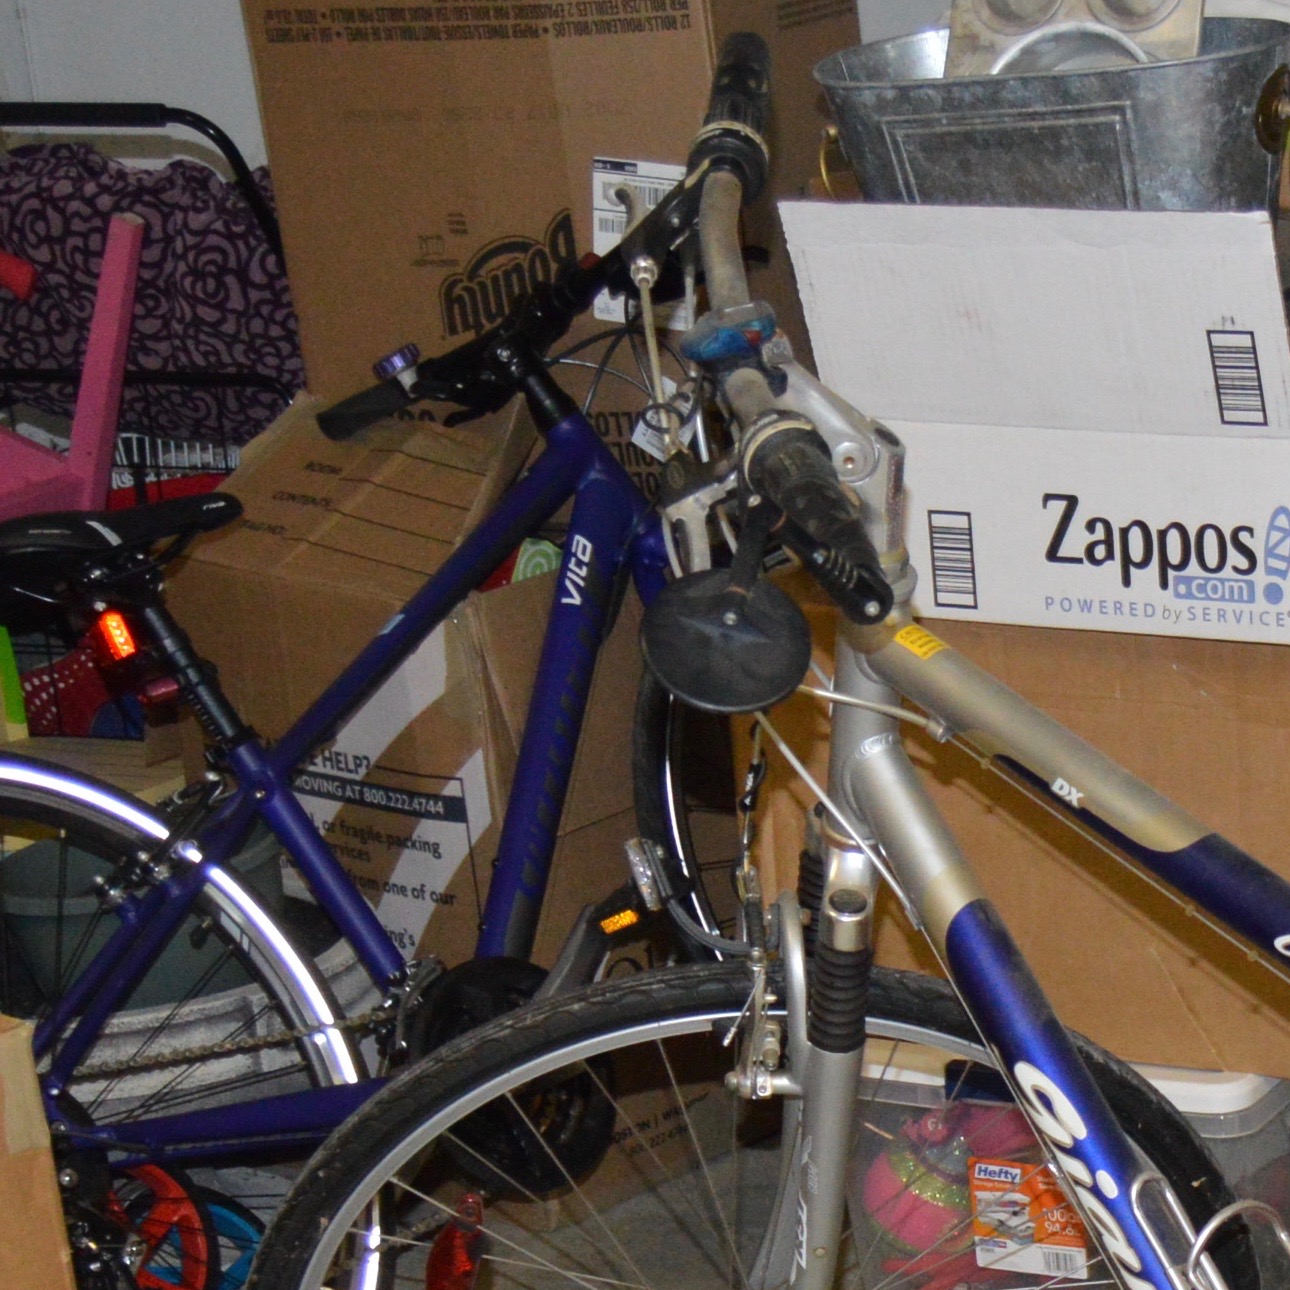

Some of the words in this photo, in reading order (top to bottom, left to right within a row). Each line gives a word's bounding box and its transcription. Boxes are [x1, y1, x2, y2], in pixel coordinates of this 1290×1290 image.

[1041, 493, 1258, 591] Zappos
[1044, 596, 1156, 619] POWERED
[1162, 602, 1183, 624] by
[322, 751, 371, 775] HELP?
[344, 786, 361, 800] AT
[363, 789, 445, 815] 800.222.4744
[1051, 777, 1085, 809] DX
[386, 834, 442, 860] packing
[383, 878, 409, 897] one
[411, 883, 427, 901] of
[429, 890, 456, 906] our
[976, 1165, 1019, 1183] Hefty
